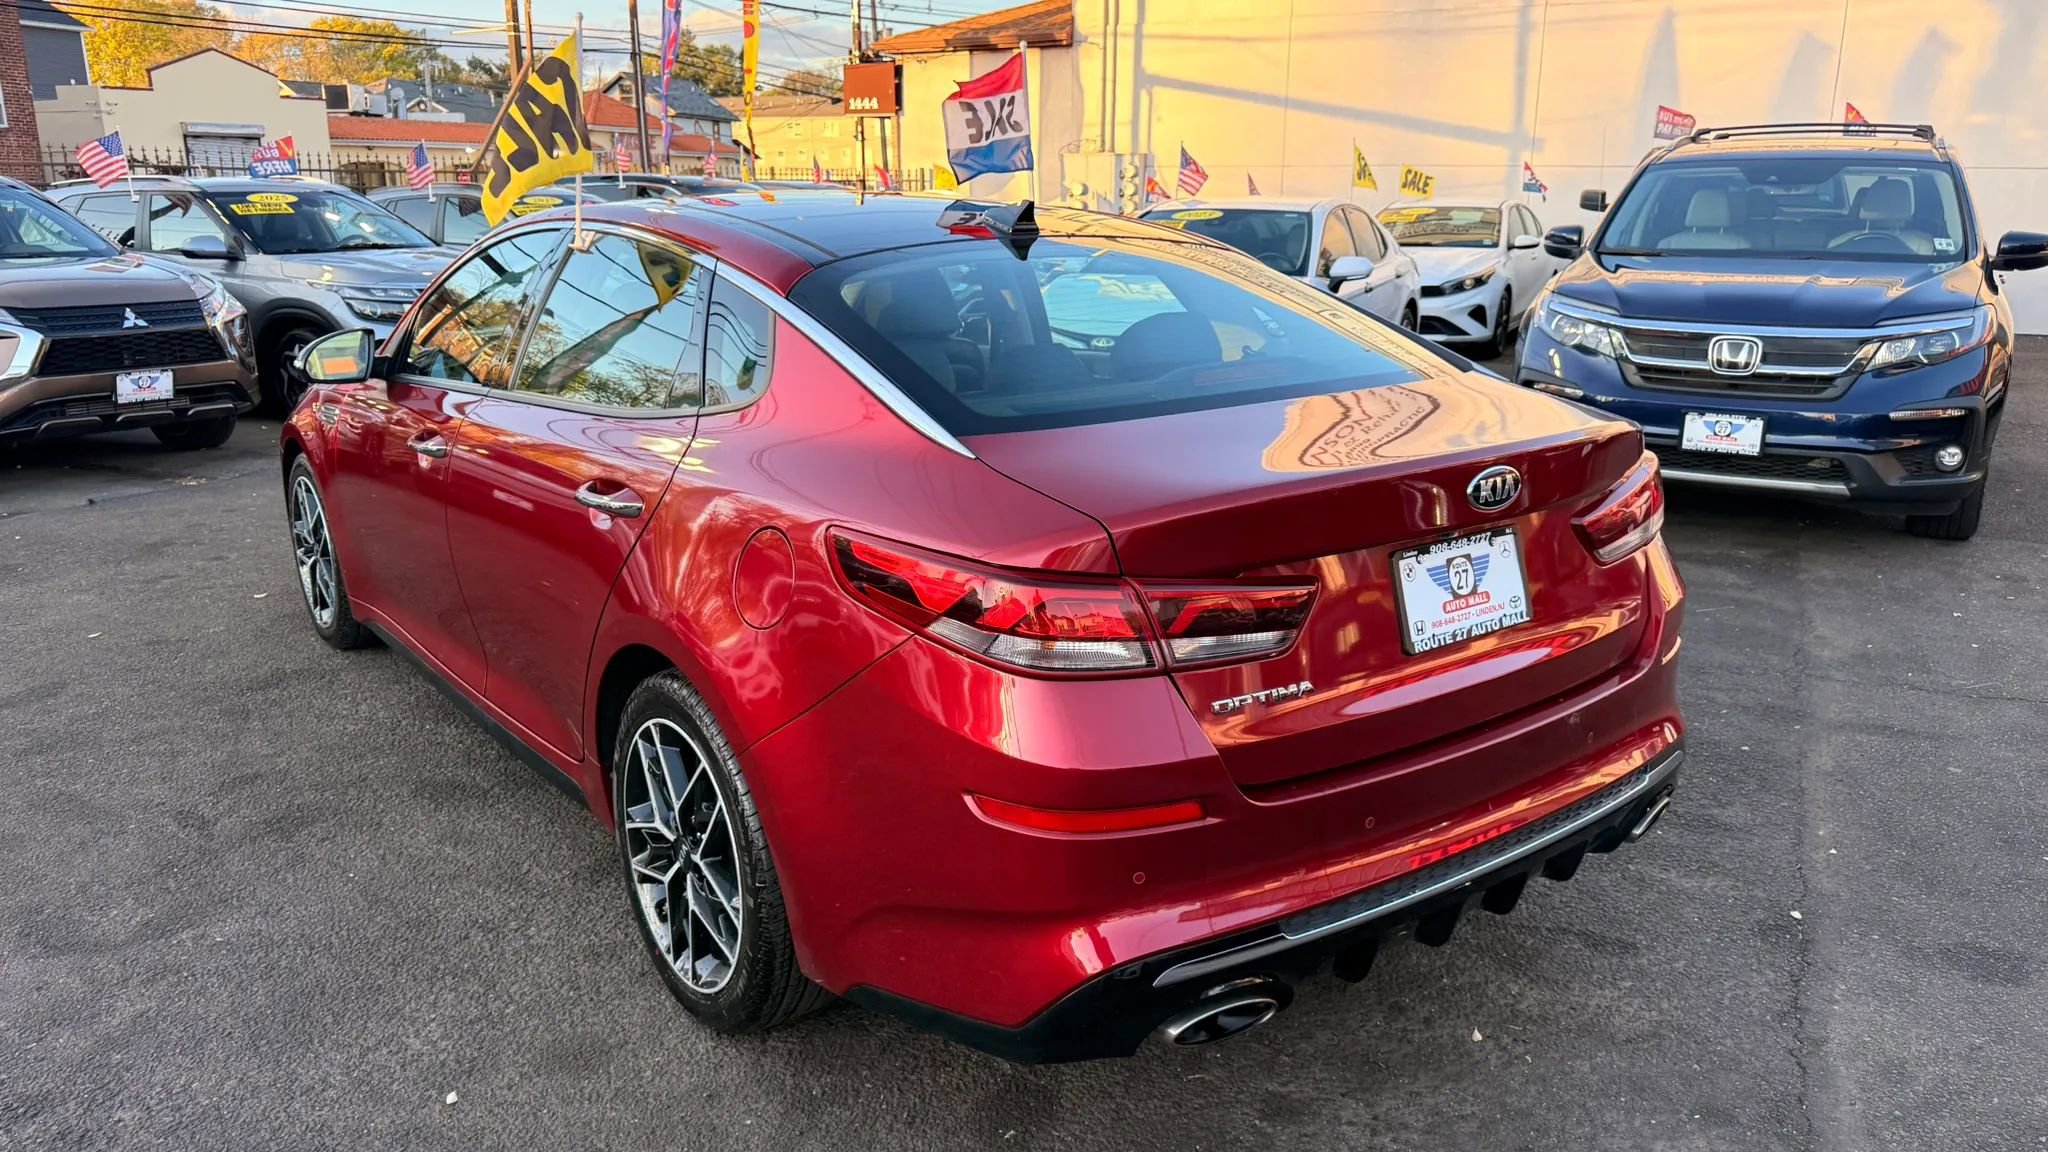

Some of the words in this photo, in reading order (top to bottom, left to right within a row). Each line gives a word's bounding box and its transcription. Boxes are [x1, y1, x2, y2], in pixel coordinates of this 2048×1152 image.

[849, 97, 879, 110] 1444
[1401, 169, 1432, 194] SALE
[1718, 426, 1728, 434] 27
[1479, 474, 1515, 503] KIA
[1429, 532, 1491, 555] 908-648-2727
[1452, 562, 1468, 570] ROUTE
[1454, 569, 1468, 591] 27
[1445, 599, 1466, 612] AUTO
[1468, 593, 1489, 606] MALL
[1414, 633, 1454, 653] ROUTE
[1455, 628, 1468, 640] 27
[1472, 620, 1500, 637] AUTO
[1502, 611, 1530, 627] MALL
[1211, 681, 1315, 713] OPTIMA
